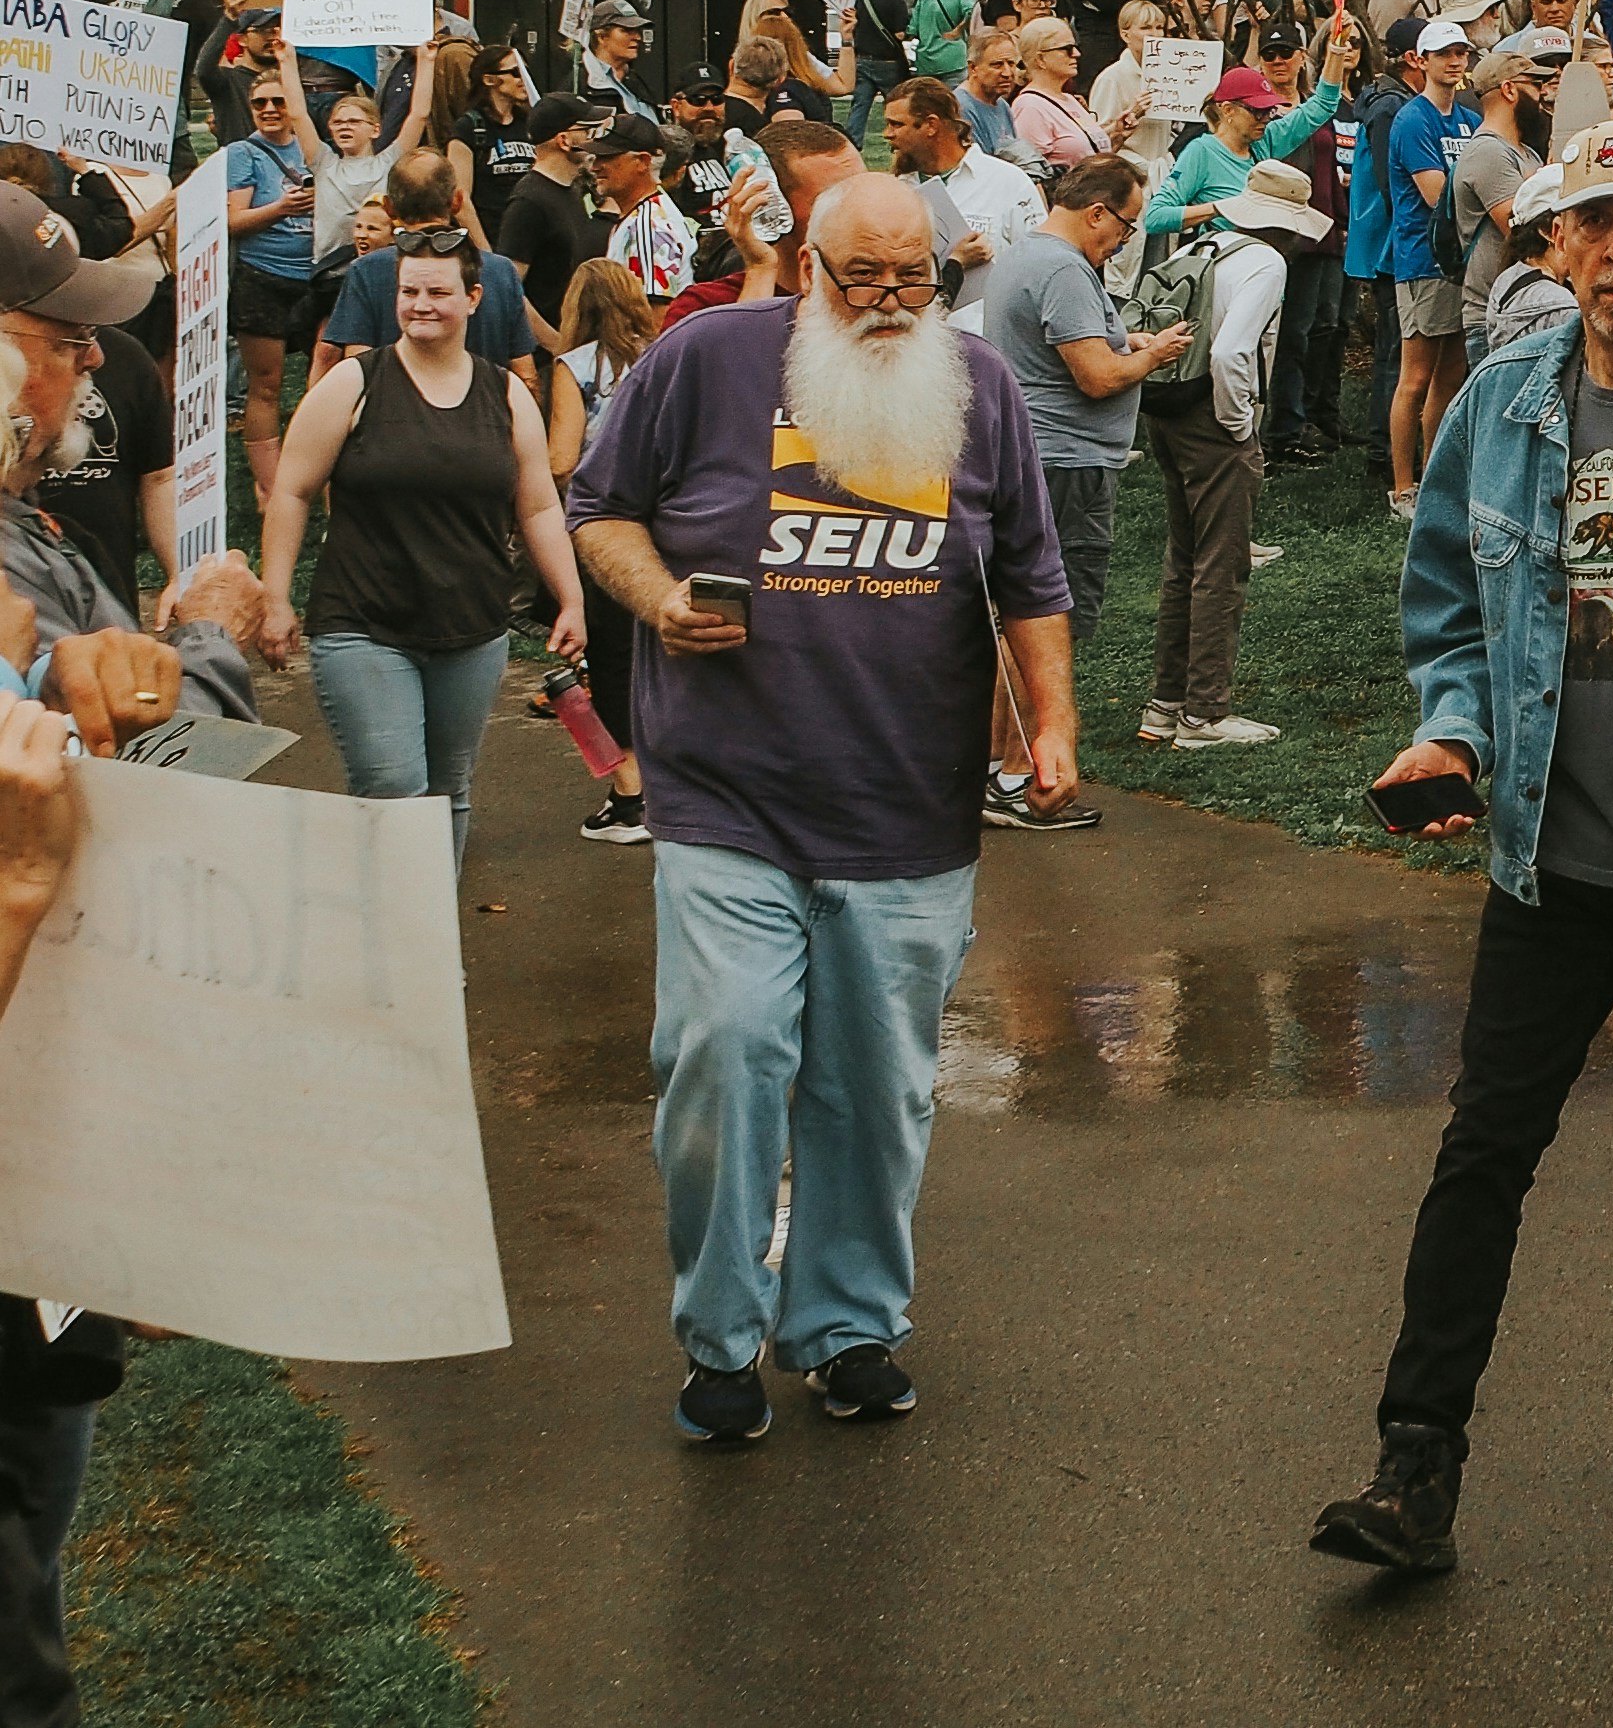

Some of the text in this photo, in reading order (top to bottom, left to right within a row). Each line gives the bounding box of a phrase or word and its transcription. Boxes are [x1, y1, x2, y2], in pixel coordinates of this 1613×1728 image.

[83, 8, 156, 52] GLORY
[108, 43, 128, 57] TO
[1146, 39, 1164, 57] If
[80, 49, 178, 98] UKRAINE
[66, 83, 124, 121] PUTIN
[148, 105, 171, 135] A
[59, 123, 171, 166] WAR CRIMINAL
[180, 238, 219, 325] FIGHT
[180, 306, 219, 387] TRUTH
[759, 513, 948, 571] SEIU
[761, 571, 941, 599] Stronger Together
